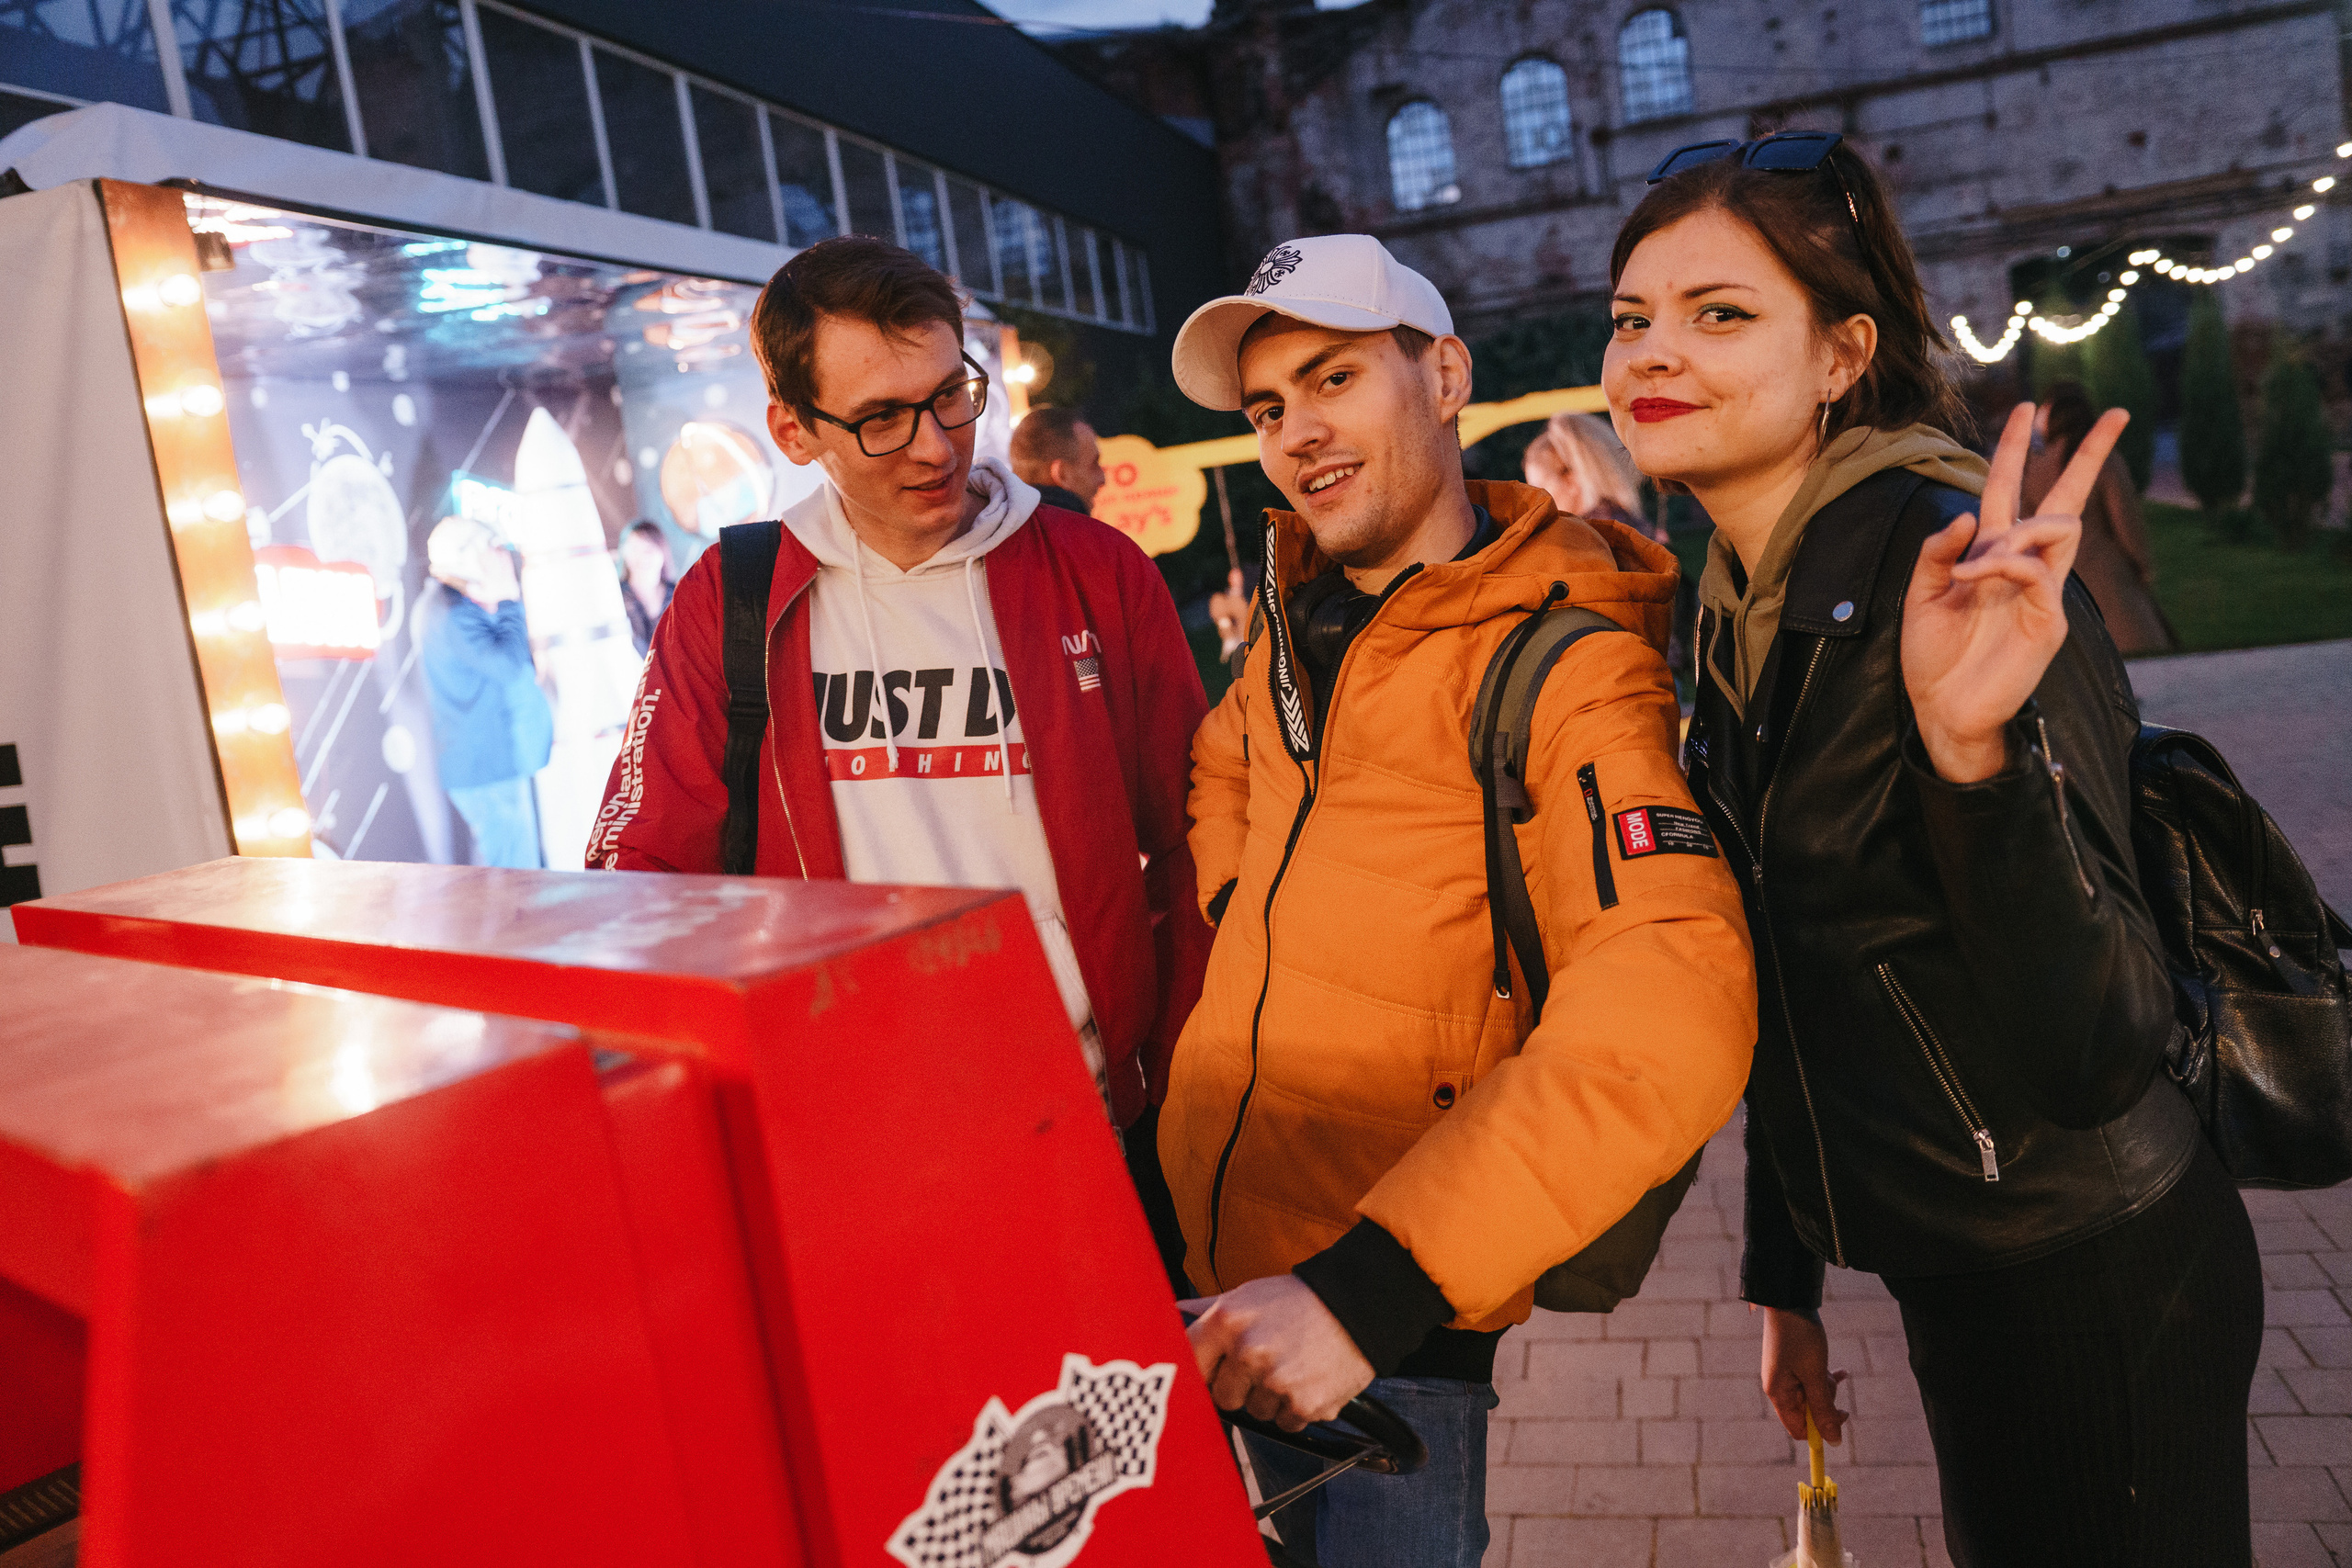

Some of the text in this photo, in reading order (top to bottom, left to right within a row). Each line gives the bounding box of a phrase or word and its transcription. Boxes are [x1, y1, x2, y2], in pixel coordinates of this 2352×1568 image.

[601, 688, 662, 852] ministration.
[825, 750, 1033, 775] OHIN
[1625, 812, 1649, 850] MODE
